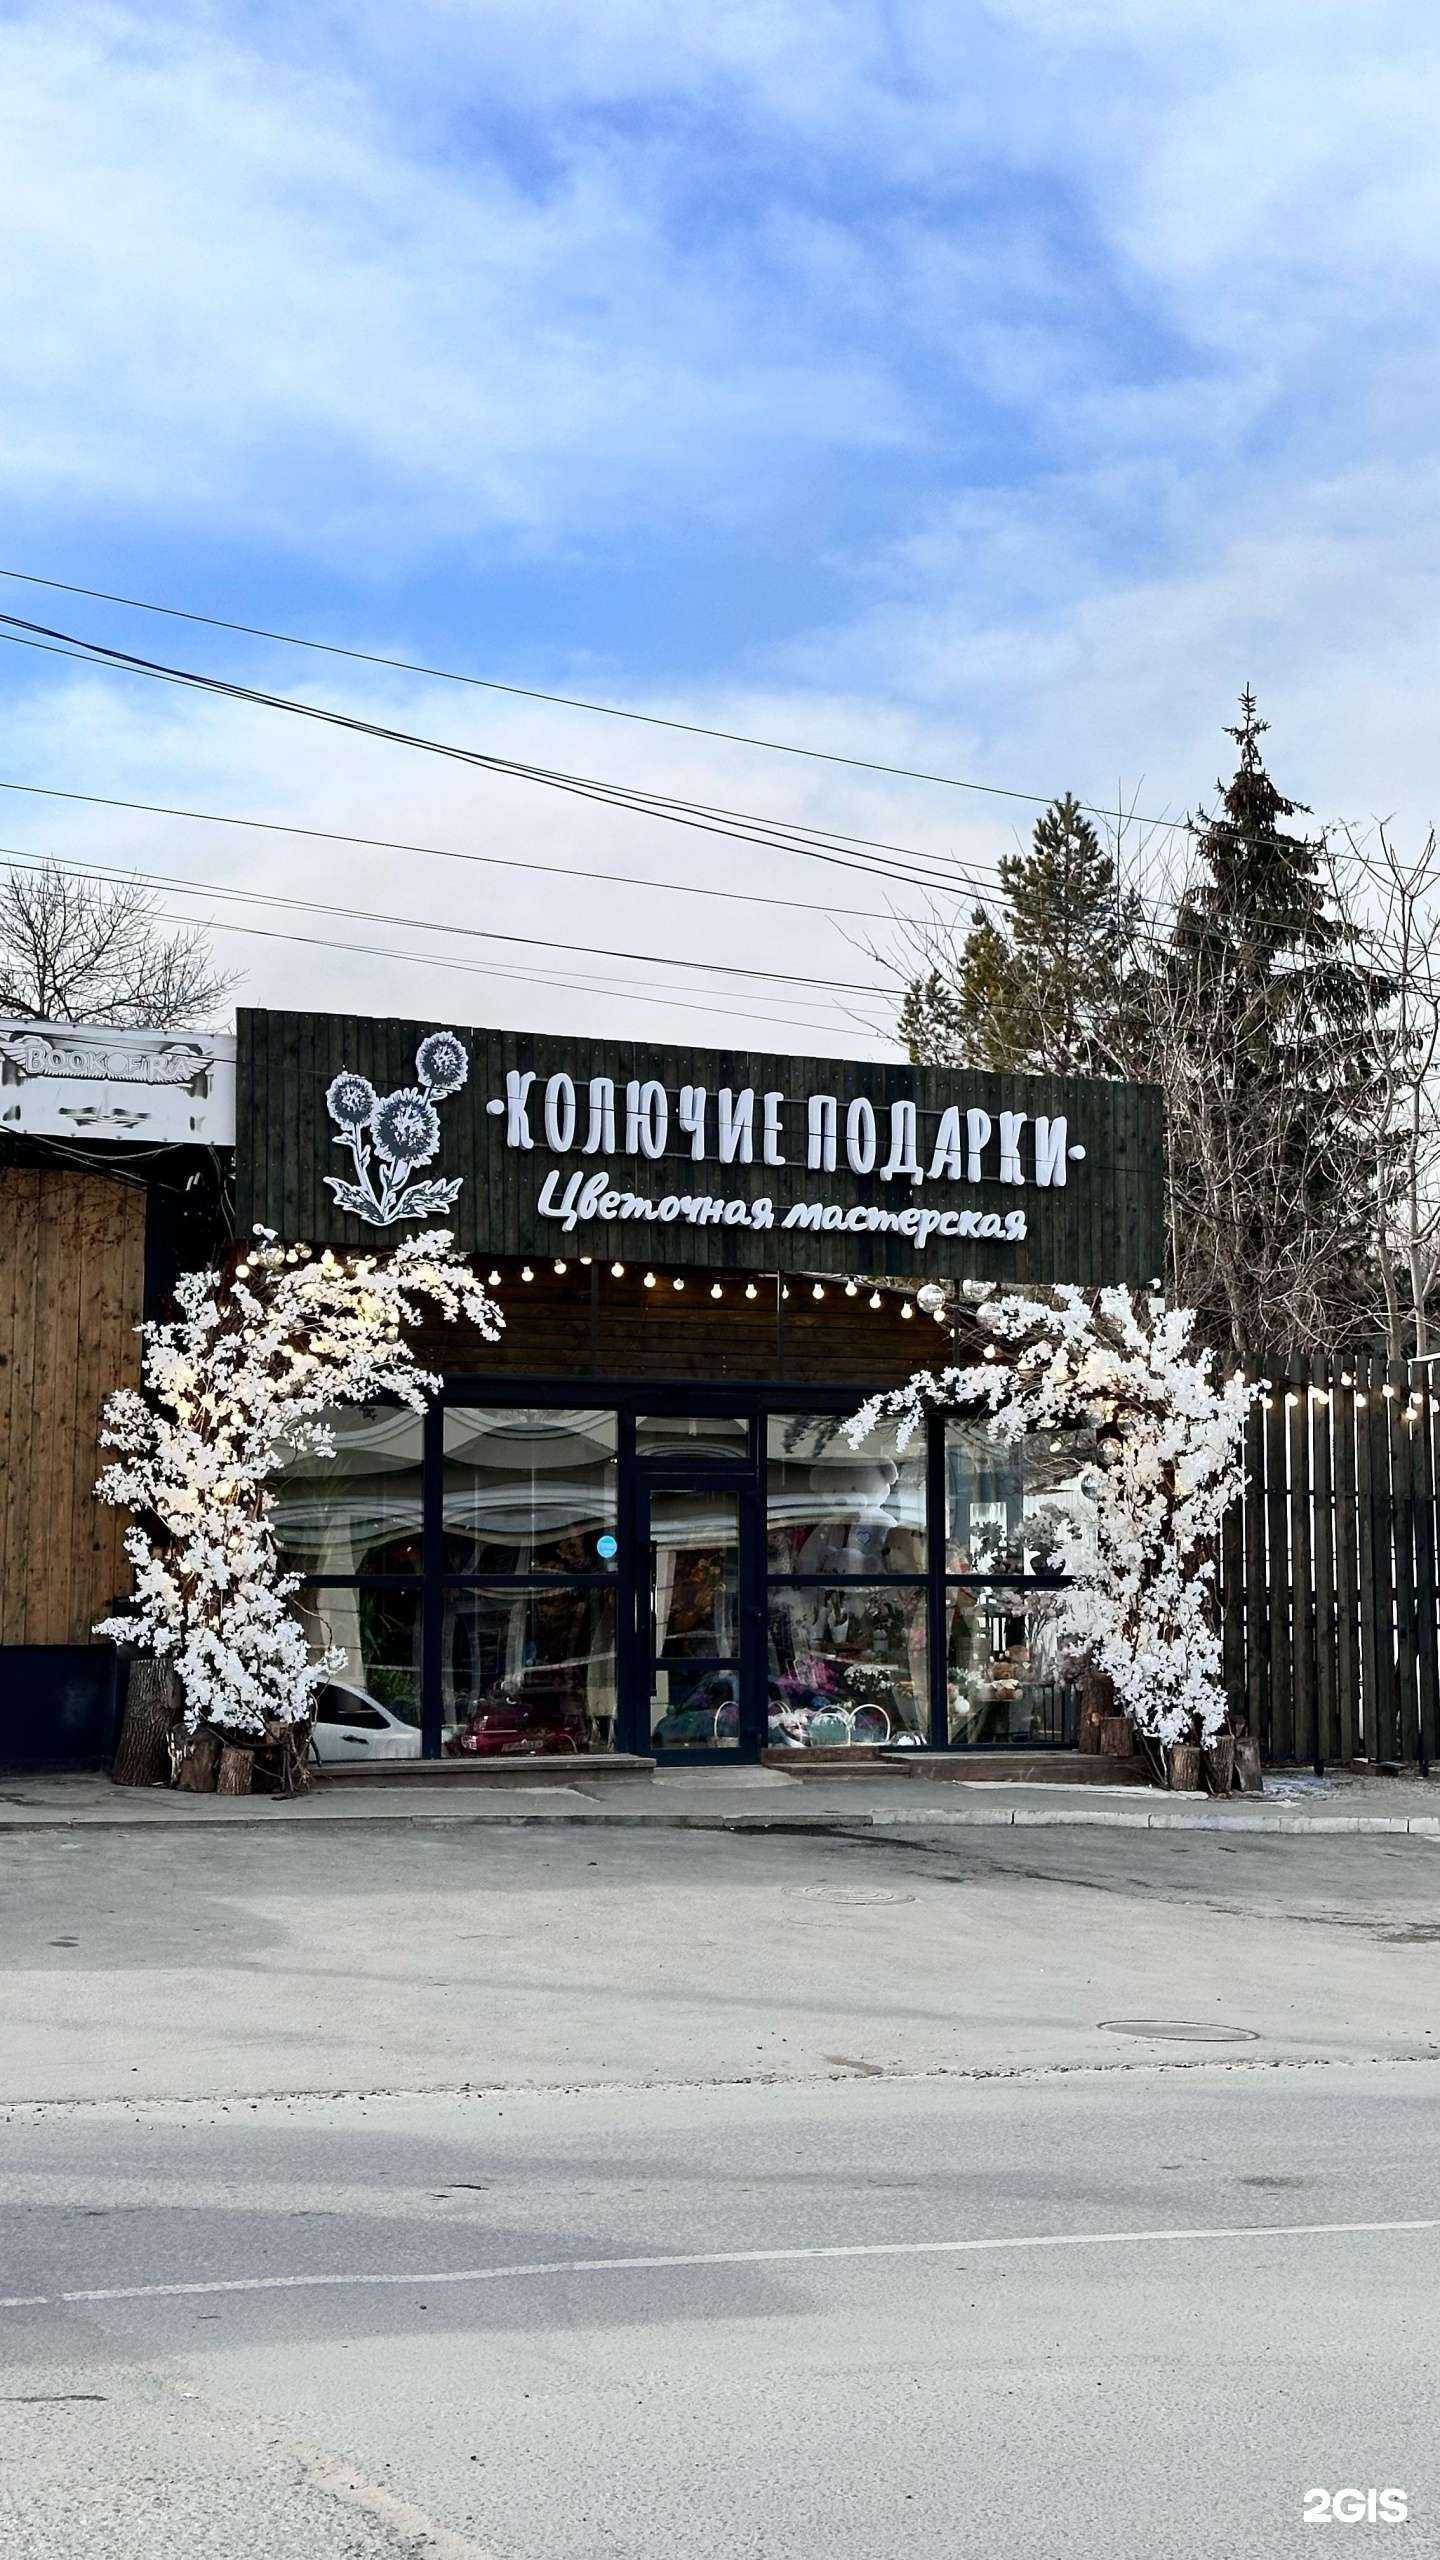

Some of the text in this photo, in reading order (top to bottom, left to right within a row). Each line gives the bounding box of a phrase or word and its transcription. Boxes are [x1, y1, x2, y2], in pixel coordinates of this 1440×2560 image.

[506, 1070, 1068, 1187] КОЛЮЧИЕ ПОДАРКИ
[538, 1169, 1028, 1249] Цветочная мастерская
